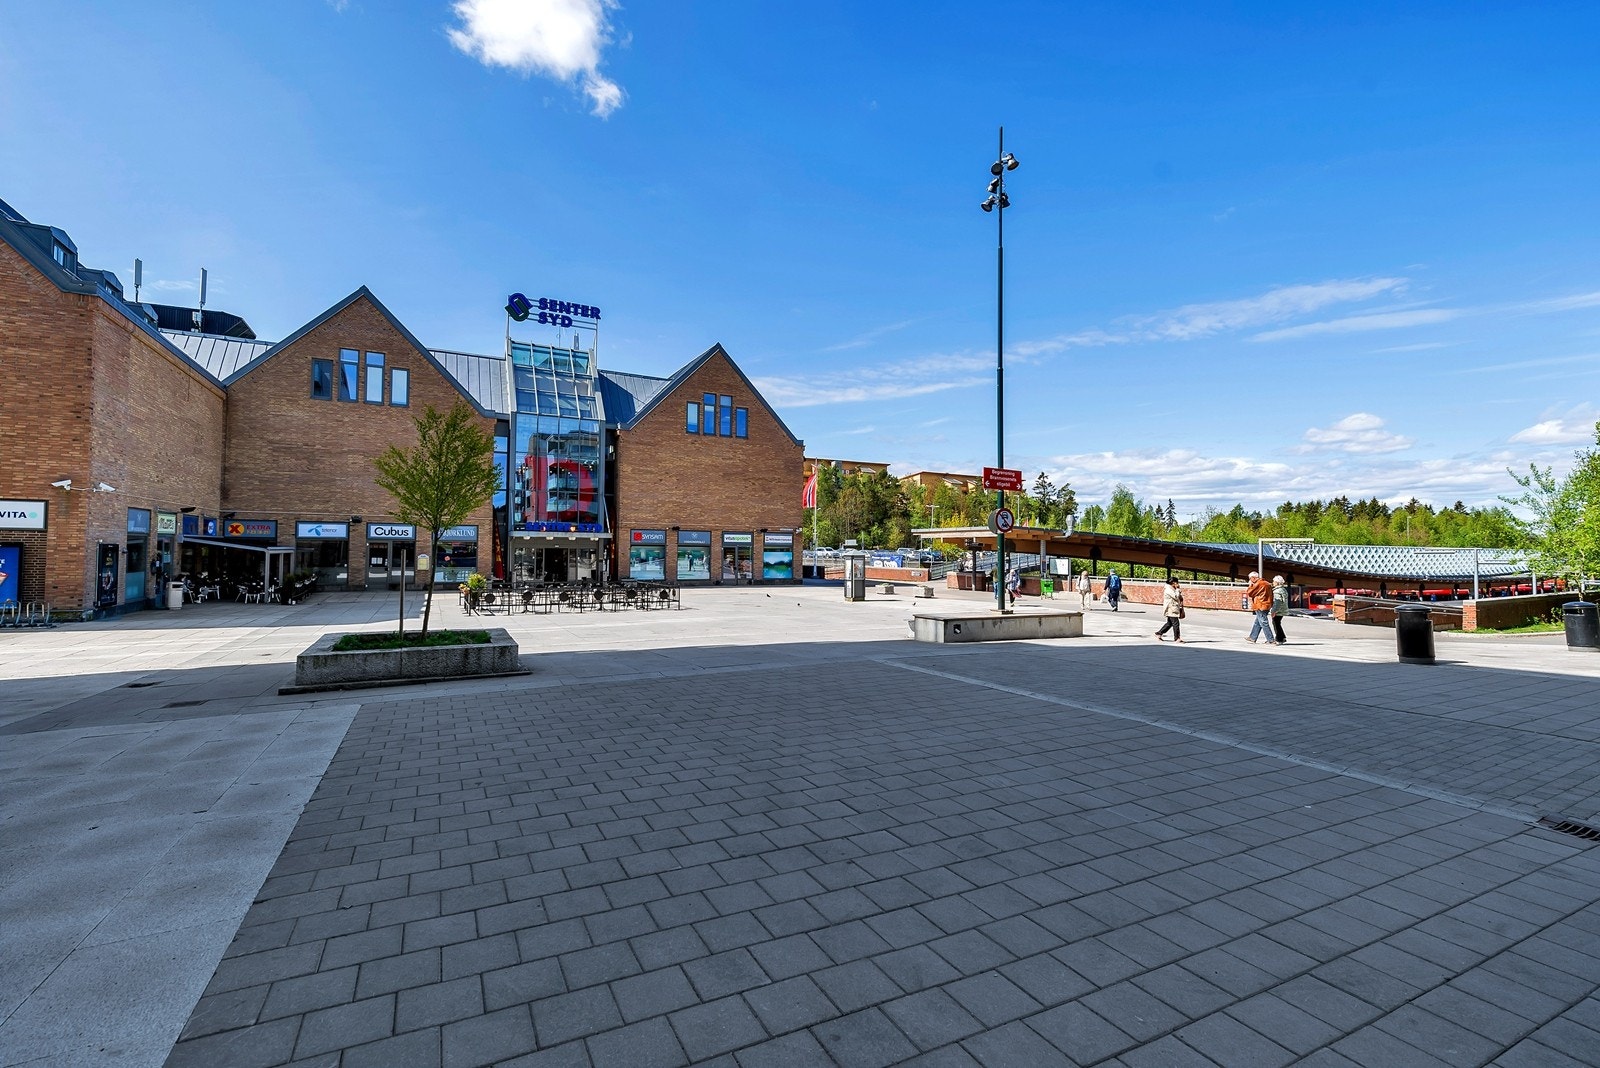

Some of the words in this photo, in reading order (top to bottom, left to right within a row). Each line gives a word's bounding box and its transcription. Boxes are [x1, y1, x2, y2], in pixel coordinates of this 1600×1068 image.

[538, 297, 602, 320] SENTER
[538, 311, 573, 328] SYD
[0, 511, 28, 519] VITA
[374, 526, 409, 537] Cubus
